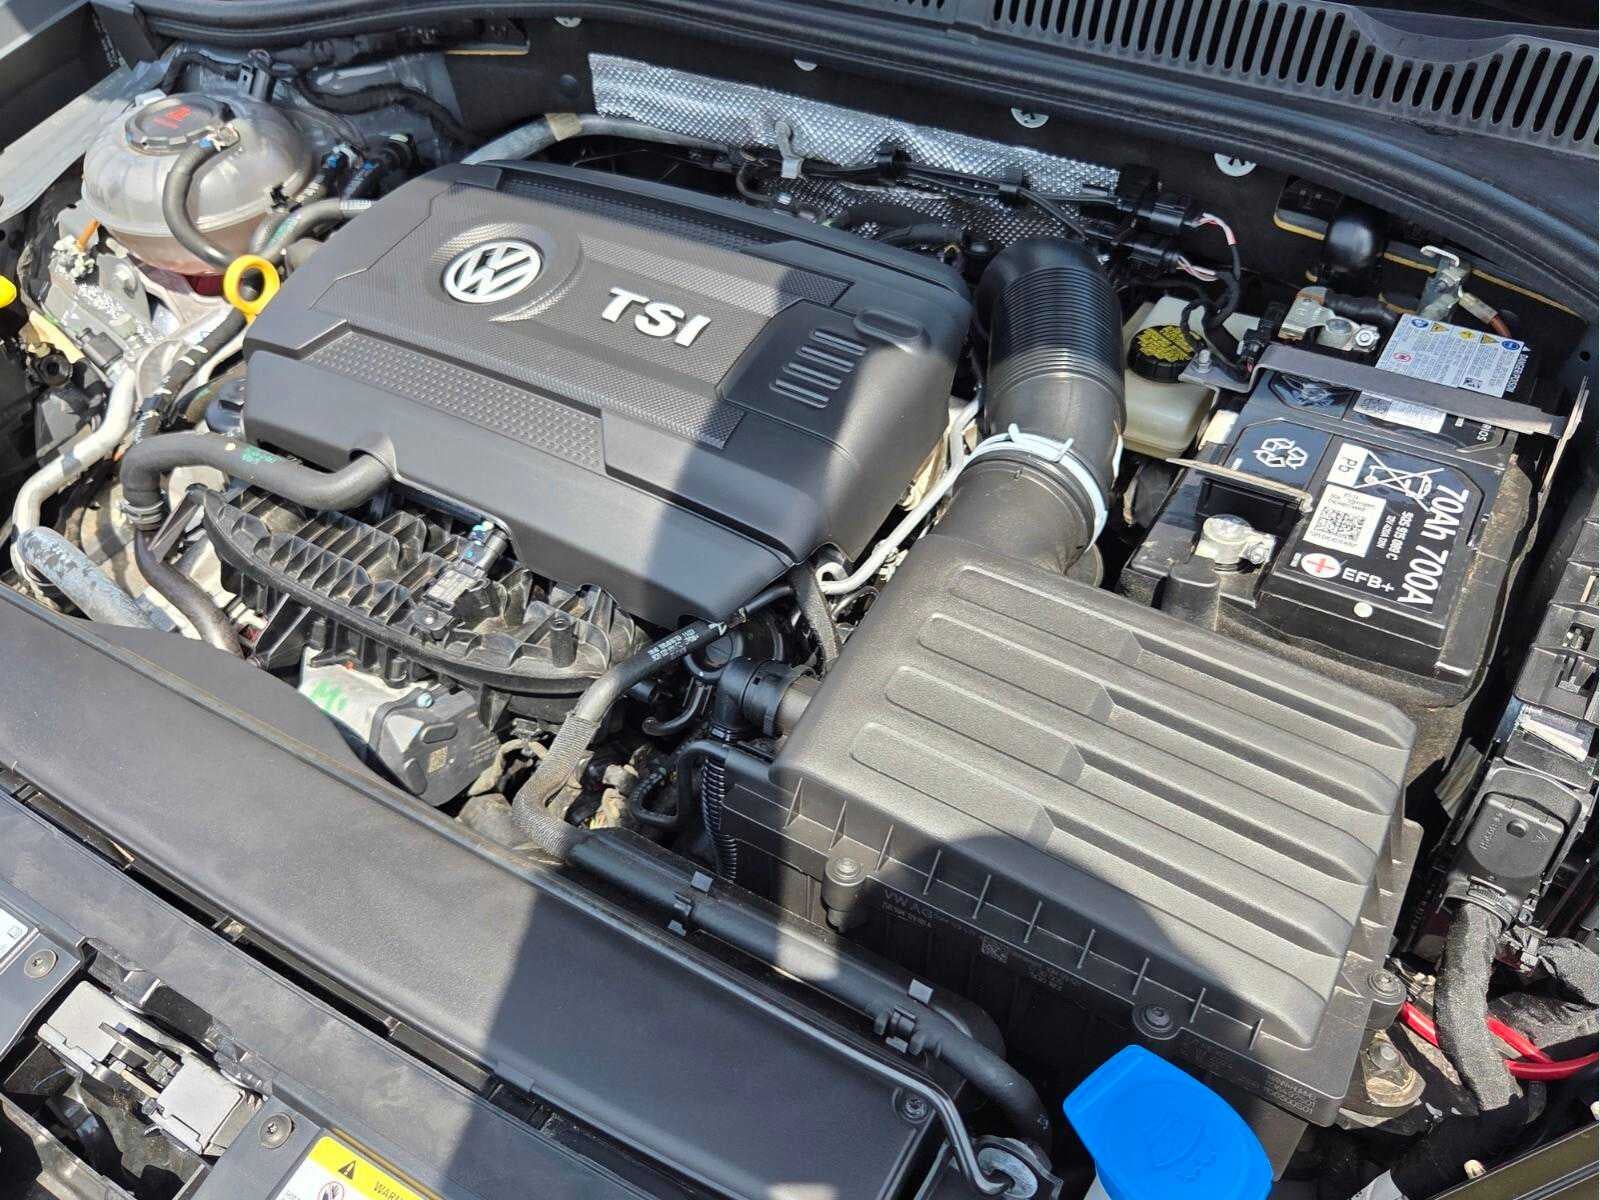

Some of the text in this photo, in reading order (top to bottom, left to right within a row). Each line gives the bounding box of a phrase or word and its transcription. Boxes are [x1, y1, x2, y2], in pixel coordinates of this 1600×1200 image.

[443, 240, 542, 304] VW
[601, 286, 712, 348] TSI
[1338, 457, 1359, 474] Pb
[1396, 484, 1469, 606] 70Ah 700A
[1343, 567, 1396, 593] EFB+
